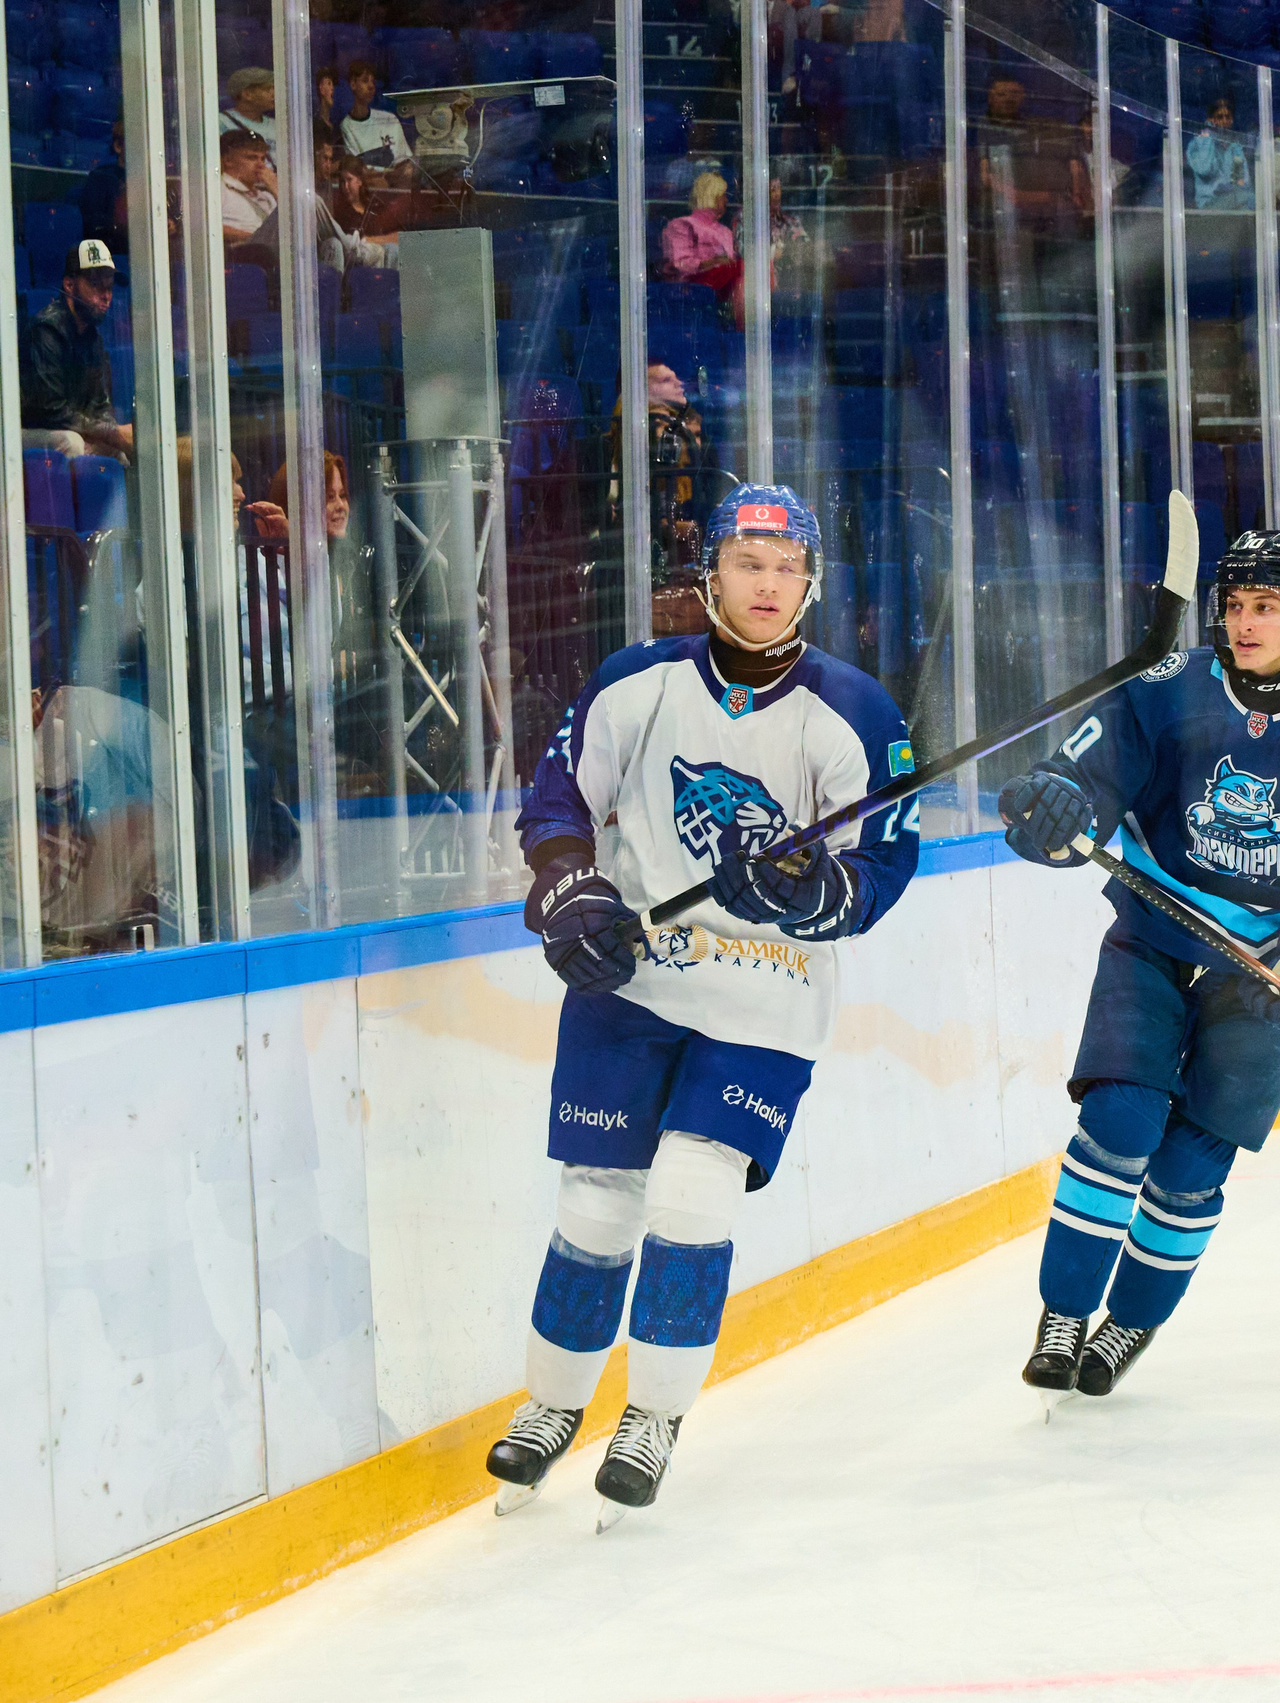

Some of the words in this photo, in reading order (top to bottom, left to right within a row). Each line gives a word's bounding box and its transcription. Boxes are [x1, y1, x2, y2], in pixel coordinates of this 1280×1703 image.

[664, 34, 702, 57] 14
[808, 164, 834, 188] 12
[740, 520, 784, 529] OLIMPBET
[1059, 715, 1103, 763] 0
[1207, 828, 1271, 847] СИБИРСКИЕ
[715, 937, 811, 975] SAMRUK
[714, 953, 810, 987] KAZYNA
[574, 1105, 629, 1131] Halyk
[744, 1093, 788, 1137] Halyk
